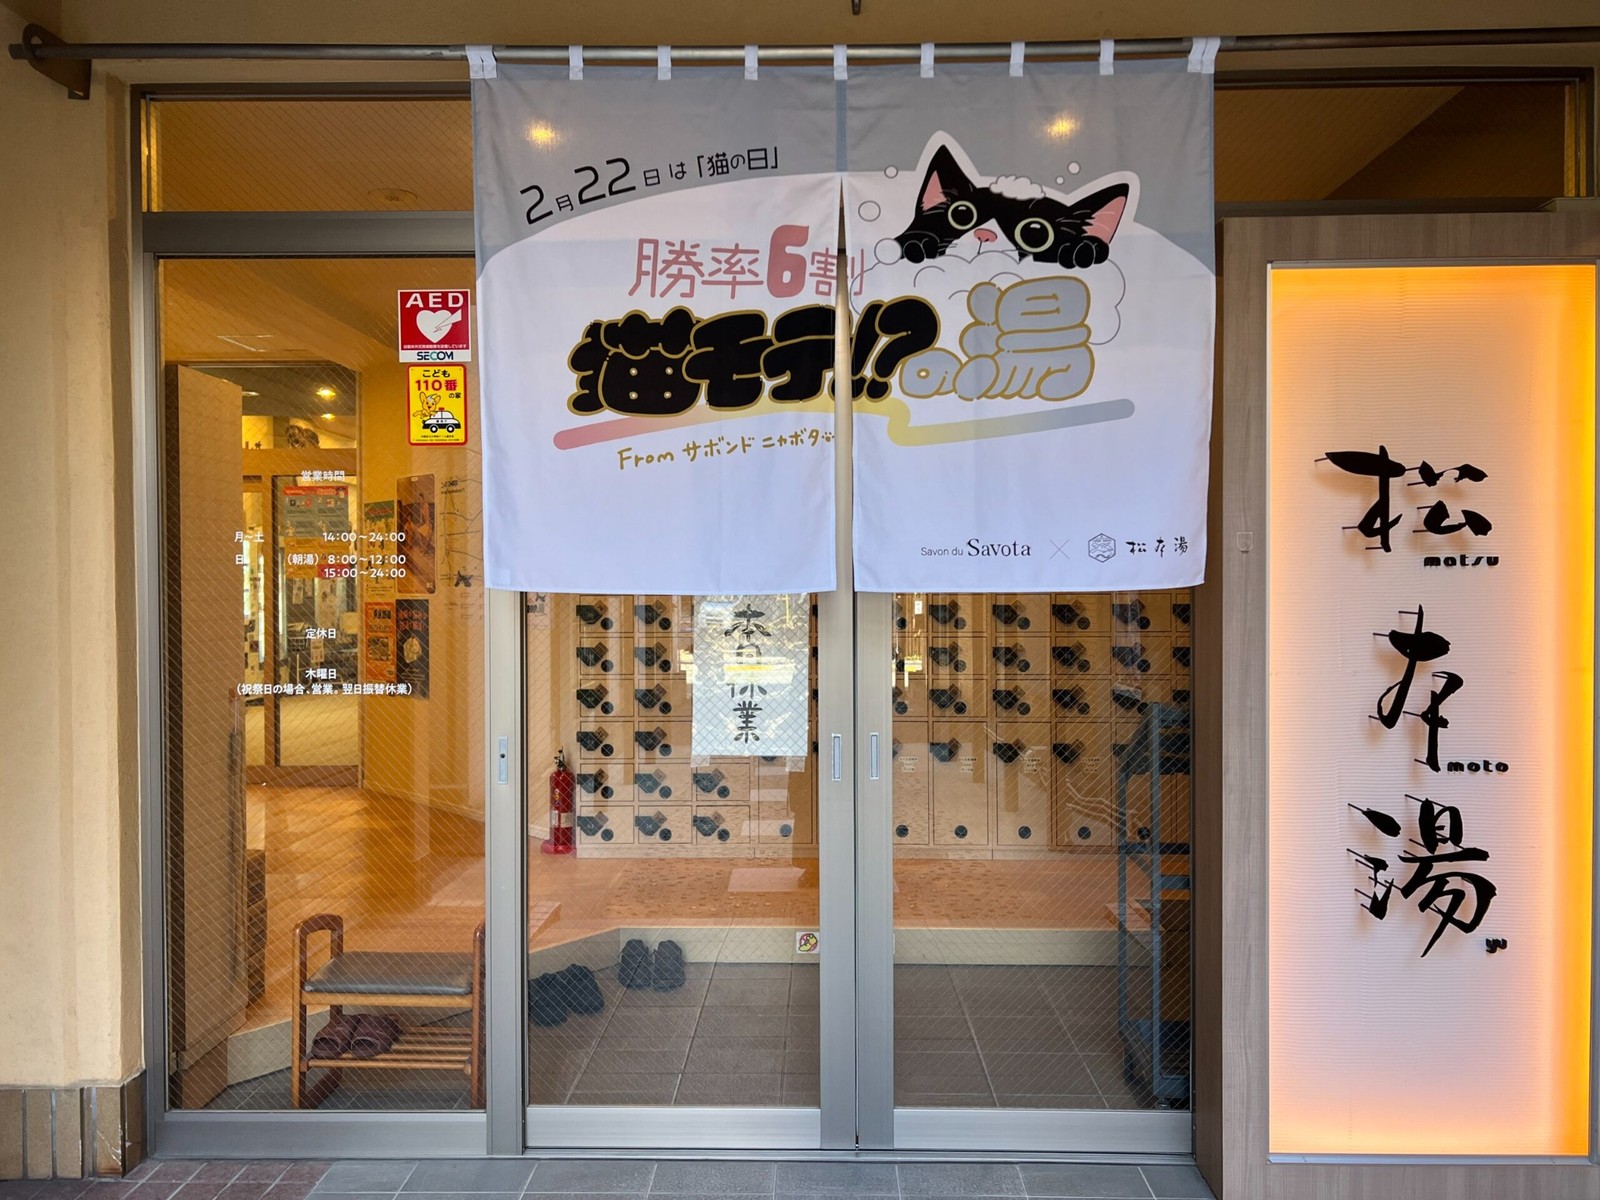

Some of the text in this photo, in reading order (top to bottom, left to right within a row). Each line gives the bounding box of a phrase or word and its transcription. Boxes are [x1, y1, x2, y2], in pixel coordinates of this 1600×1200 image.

[627, 225, 865, 299] 勝率6割
[404, 292, 465, 308] AED
[416, 351, 454, 361] SECOM
[422, 369, 451, 378] こども
[415, 379, 458, 391] 110番
[617, 447, 675, 470] From
[682, 435, 755, 462] サボンド
[301, 470, 345, 482] 営業時間
[920, 538, 1032, 557] Savon du Savota
[1423, 554, 1500, 567] matsu
[305, 627, 337, 639] 定休日
[305, 668, 337, 680] 木曜日
[1447, 759, 1510, 773] moto
[1485, 937, 1508, 954] yu
